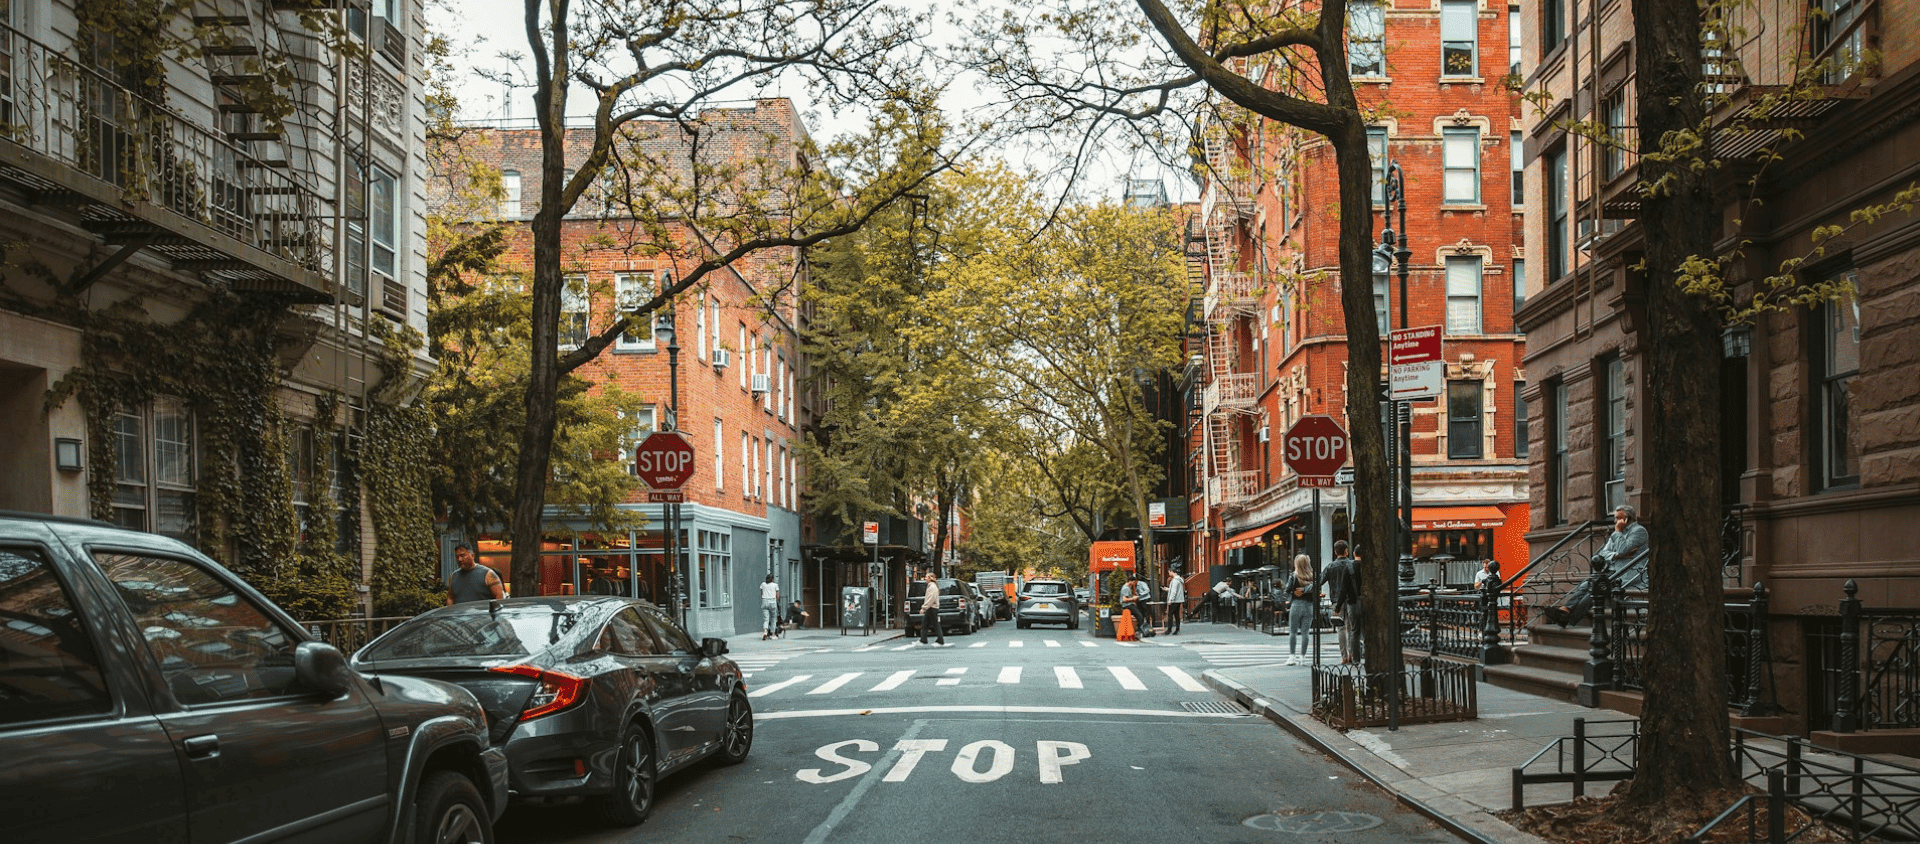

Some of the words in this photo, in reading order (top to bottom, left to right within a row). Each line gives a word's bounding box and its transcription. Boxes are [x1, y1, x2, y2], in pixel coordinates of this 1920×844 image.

[1403, 329, 1435, 340] STANDING
[1393, 341, 1419, 350] Anytime
[1404, 364, 1430, 372] PARKING
[1394, 374, 1419, 383] Anytime
[1288, 436, 1344, 460] STOP
[640, 450, 692, 472] STOP
[1301, 478, 1314, 486] ALL
[1317, 478, 1331, 486] WAY
[650, 493, 664, 501] ALL
[667, 493, 681, 501] WAY
[795, 739, 1091, 784] STOP
